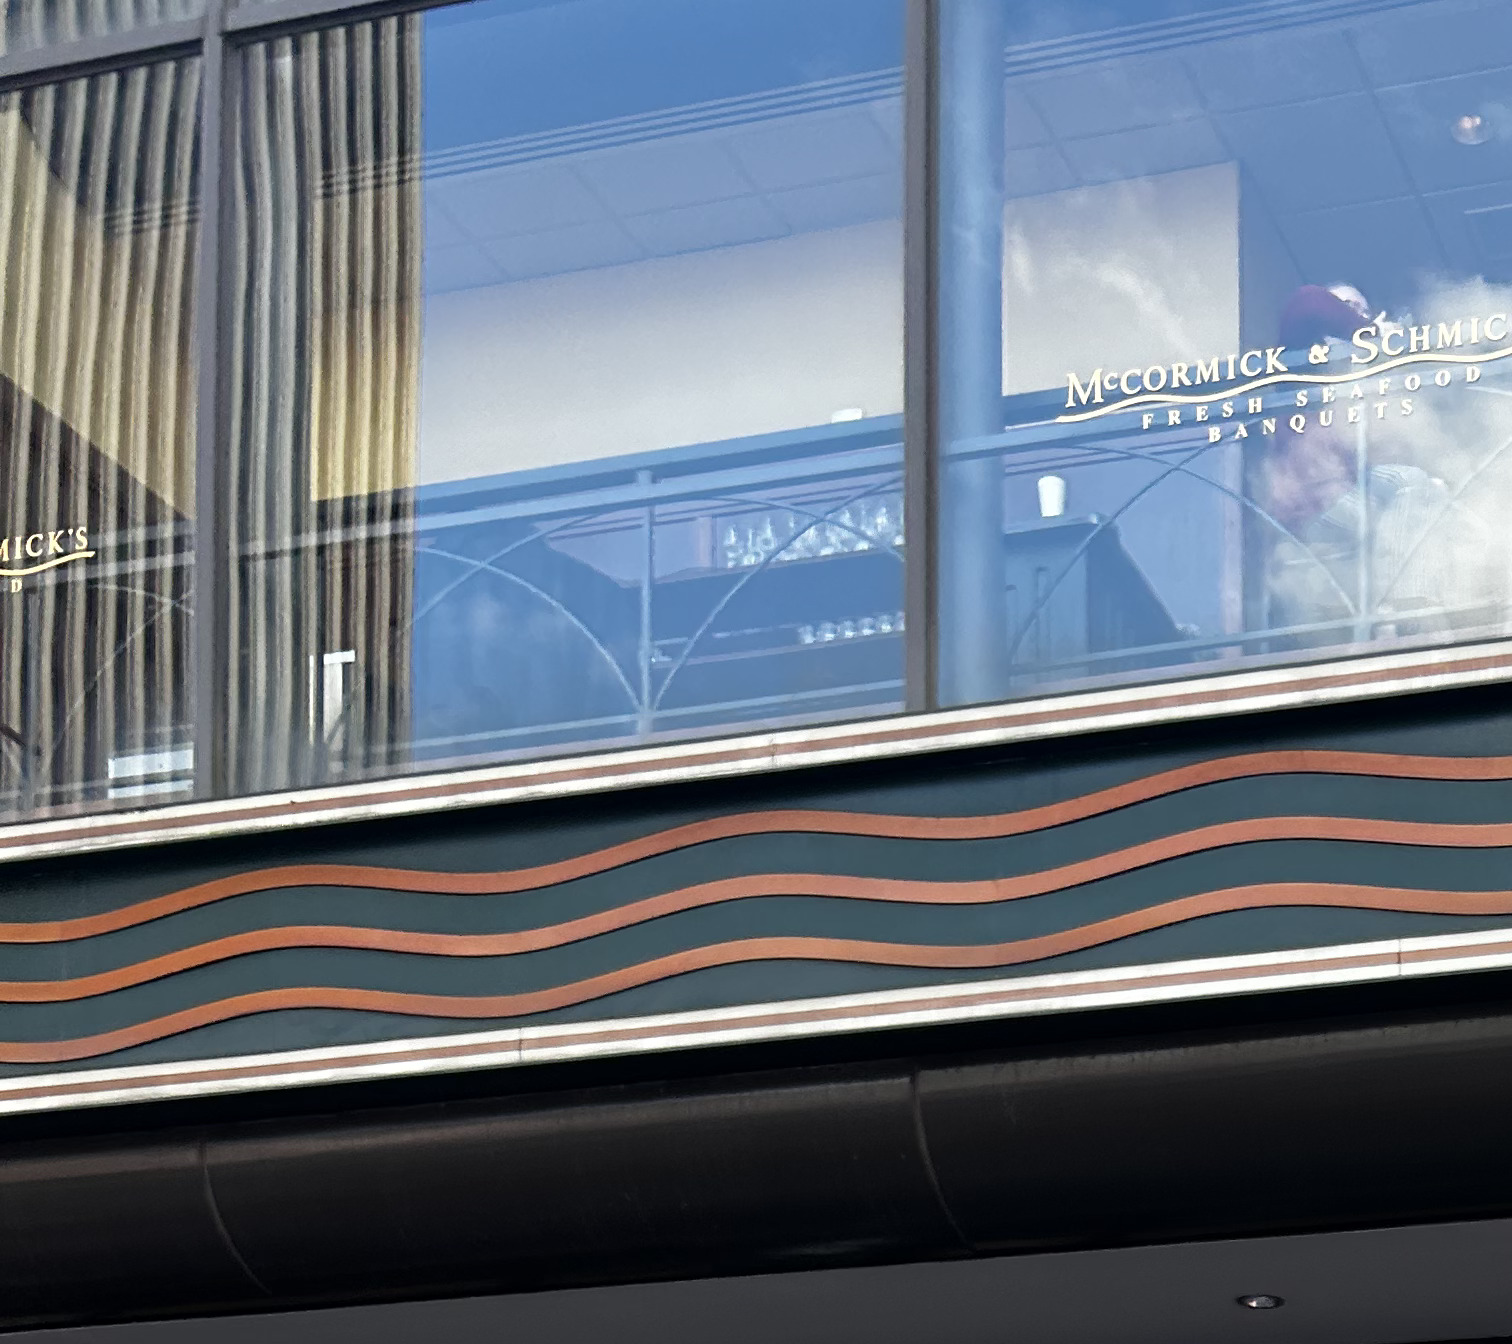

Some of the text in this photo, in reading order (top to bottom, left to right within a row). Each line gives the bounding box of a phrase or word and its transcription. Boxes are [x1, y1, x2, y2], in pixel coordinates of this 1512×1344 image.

[1308, 344, 1330, 365] &
[1142, 364, 1481, 430] FRESH SEAFOOD
[1207, 398, 1414, 443] BANQUETS
